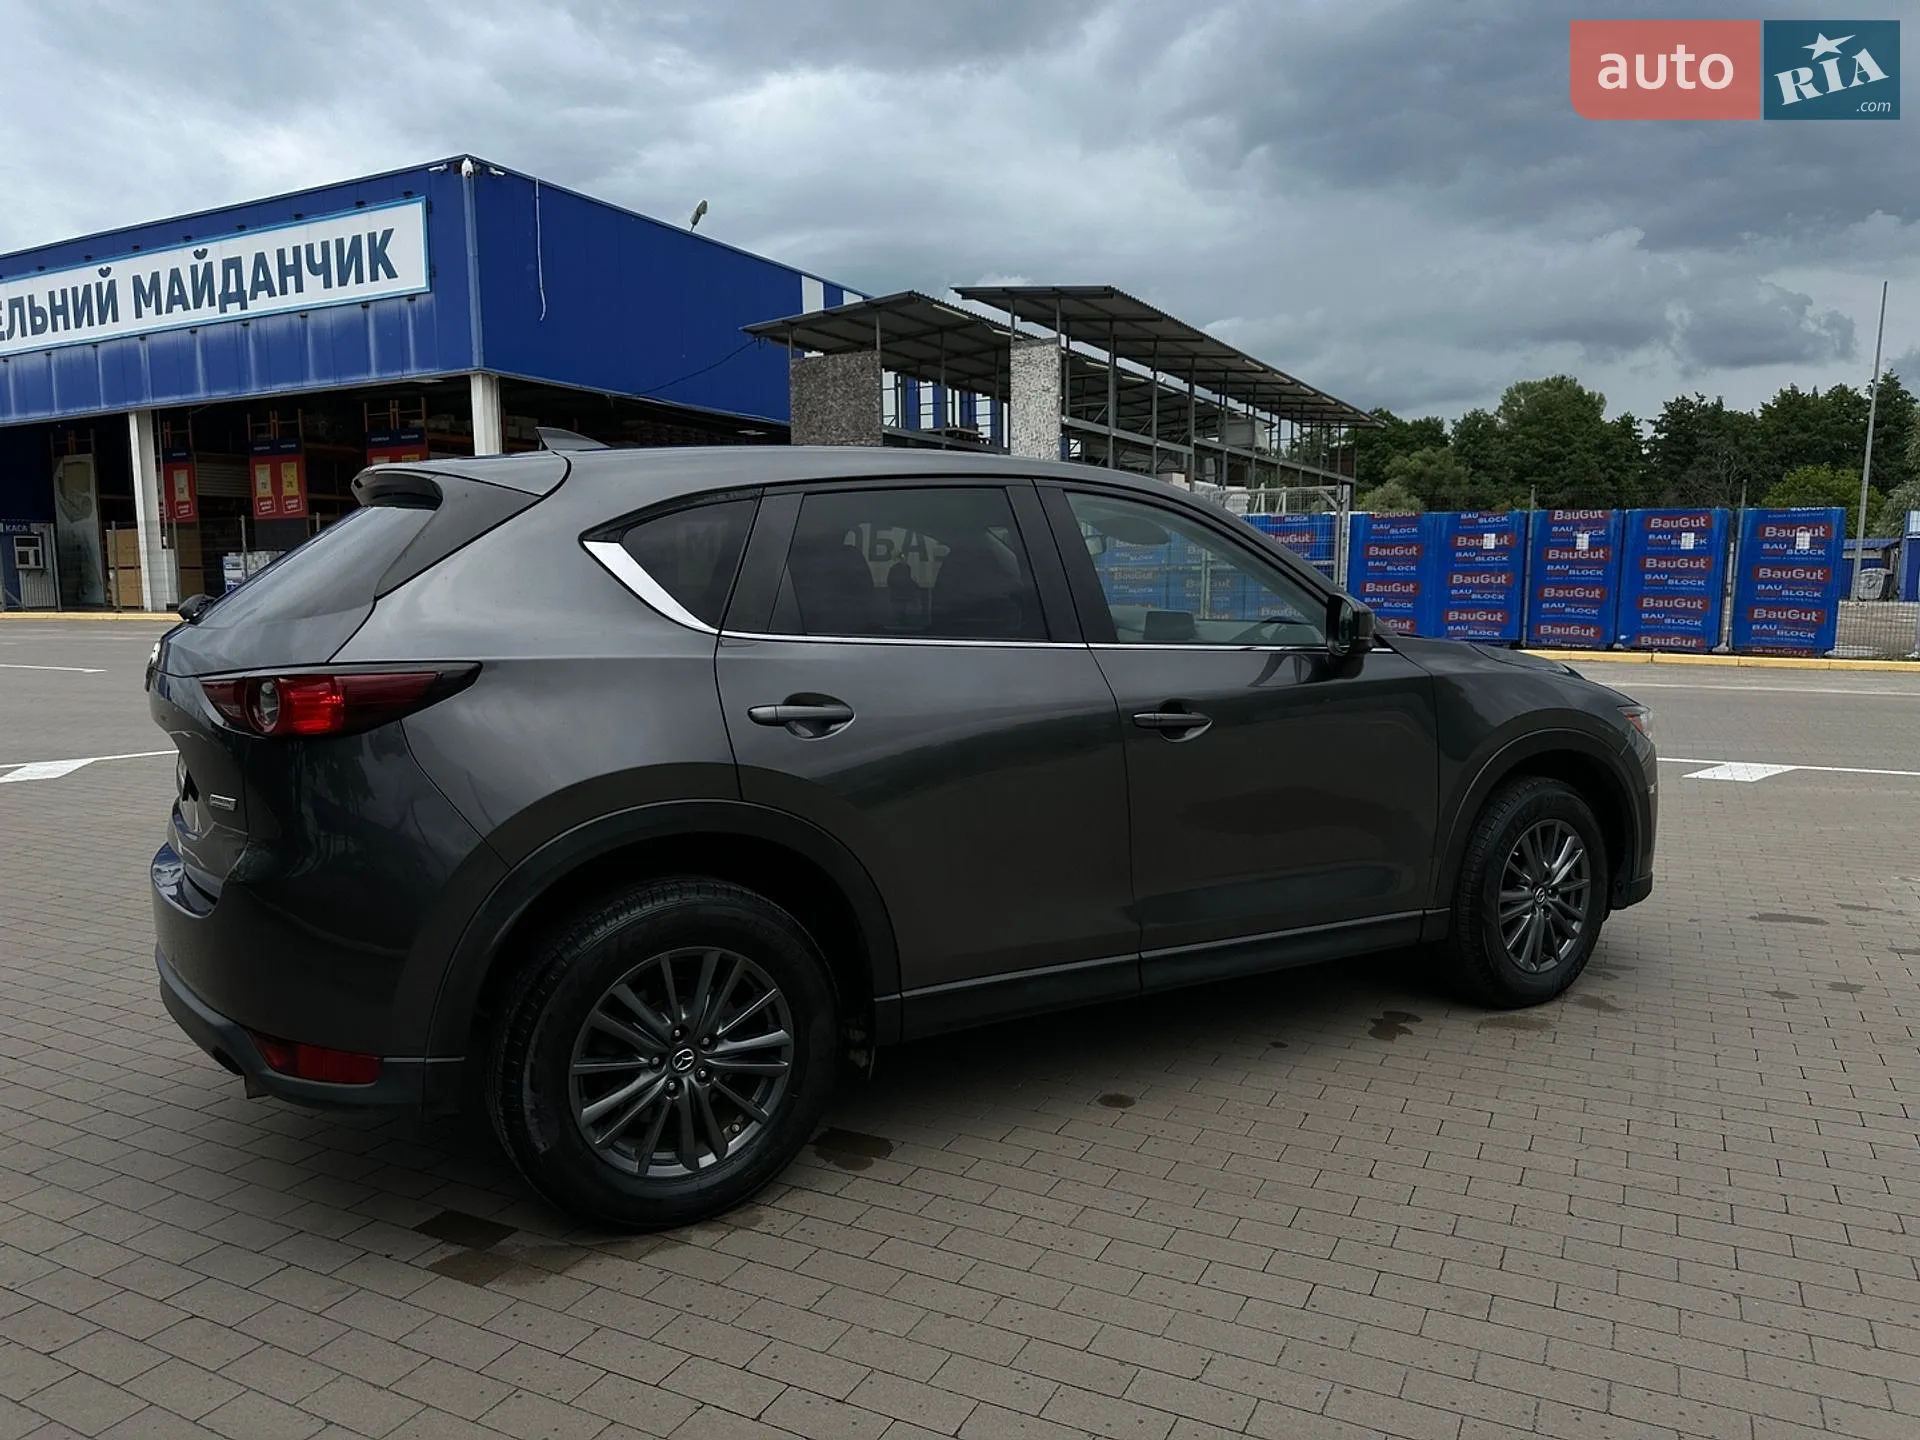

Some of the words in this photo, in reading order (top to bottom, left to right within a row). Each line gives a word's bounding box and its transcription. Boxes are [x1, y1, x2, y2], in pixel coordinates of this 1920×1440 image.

[132, 228, 398, 318] МАЙДАНЧИК
[1554, 510, 1604, 520] BauGut
[1651, 517, 1706, 528] BauGut
[6, 524, 28, 532] КАСА
[1457, 535, 1509, 546] Bauut
[1369, 546, 1417, 556] BauGut
[1548, 549, 1605, 559] BauGut
[1646, 558, 1705, 568] BauGut
[1453, 574, 1507, 584] BauGut
[1759, 568, 1824, 580] BauGut
[1365, 583, 1415, 593] BauGut
[1544, 588, 1601, 598] BauGut
[1643, 598, 1703, 609] BauGut
[1448, 611, 1503, 622] BauGut
[1753, 608, 1817, 621] BauGut
[1540, 625, 1595, 637] BauGut
[1640, 637, 1697, 647] BauGut
